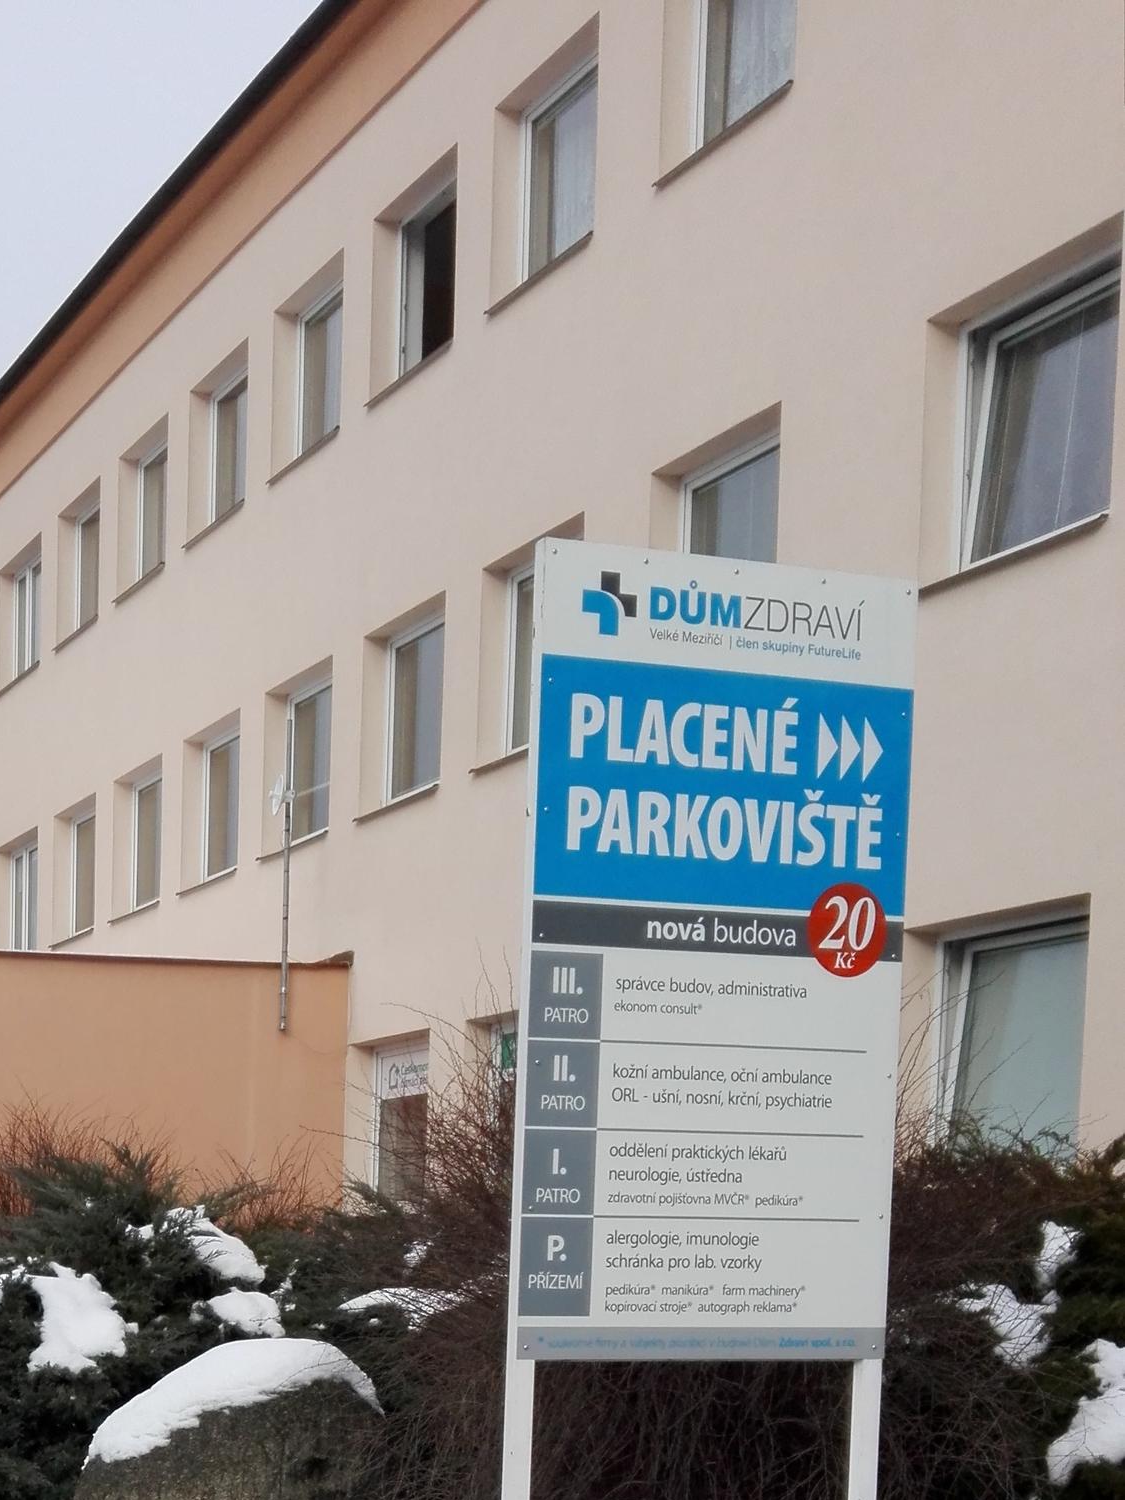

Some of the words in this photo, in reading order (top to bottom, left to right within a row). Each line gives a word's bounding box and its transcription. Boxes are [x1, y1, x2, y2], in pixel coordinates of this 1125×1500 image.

[649, 627, 679, 642] Velké
[682, 630, 723, 646] Meziříčí
[736, 636, 759, 650] člen
[763, 639, 805, 656] skupiny
[808, 644, 861, 660] FutureLife
[569, 693, 800, 775] PLACENÉ
[566, 786, 883, 871] PARKOVIŠTĚ
[646, 917, 706, 942] nová
[713, 918, 797, 947] budova
[819, 895, 876, 951] 20
[834, 952, 856, 969] Kč
[552, 966, 584, 995] III.
[615, 976, 666, 993] správce
[669, 977, 714, 995] budov,
[717, 980, 807, 999] administrativa
[544, 1007, 589, 1024] PATRO
[613, 1000, 657, 1014] ekonom
[553, 1054, 576, 1082] II.
[612, 1063, 649, 1079] kožní
[651, 1065, 726, 1083] ambulance,
[730, 1068, 760, 1083] oční
[761, 1069, 832, 1085] ambulance
[540, 1094, 586, 1111] PATRO
[611, 1087, 639, 1102] ORL
[652, 1089, 682, 1106] ušní,
[686, 1091, 724, 1107] nosní,
[728, 1091, 762, 1108] krční,
[765, 1093, 833, 1110] psychiatrie
[552, 1148, 567, 1175] I.
[609, 1142, 668, 1158] oddělení
[671, 1144, 745, 1163] praktických
[748, 1145, 787, 1161] lékařů
[608, 1166, 682, 1185] neurologie,
[686, 1167, 743, 1183] ústředna
[535, 1187, 581, 1203] PATRO
[607, 1191, 656, 1204] zdravotní
[547, 1234, 567, 1261] P.
[606, 1229, 682, 1248] alergologie,
[686, 1231, 760, 1249] imunologie
[605, 1253, 664, 1268] schránka
[668, 1257, 691, 1271] pro
[694, 1253, 716, 1269] lab.
[720, 1255, 762, 1272] vzorky
[528, 1271, 585, 1289] PŘÍZEMÍ
[722, 1284, 746, 1296] farm
[697, 1302, 750, 1315] autograph
